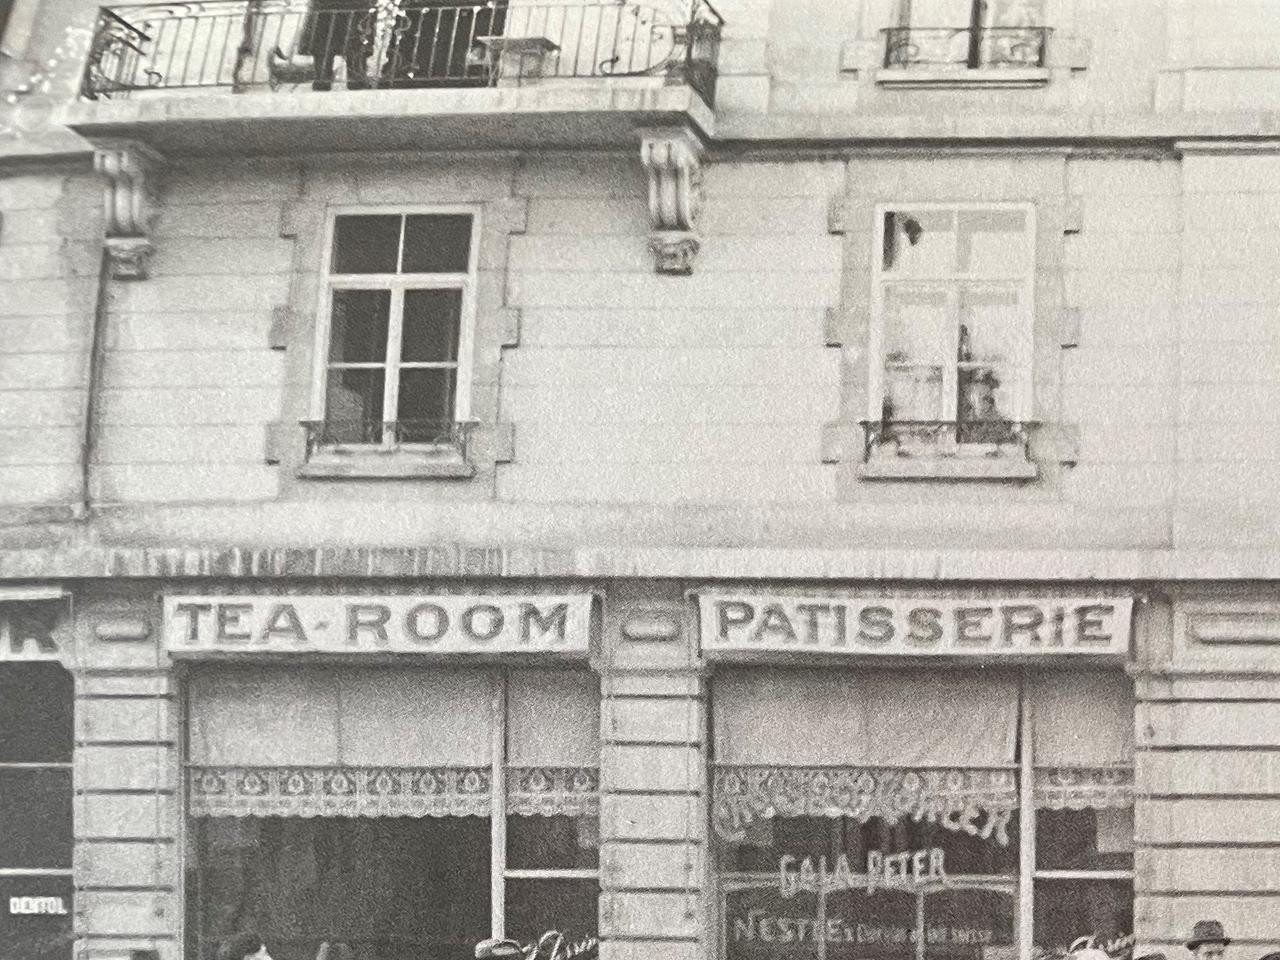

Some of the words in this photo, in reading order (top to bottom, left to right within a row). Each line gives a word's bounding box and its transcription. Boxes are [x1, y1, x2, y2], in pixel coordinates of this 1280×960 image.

[176, 602, 570, 642] TEA-ROOM
[714, 600, 1114, 645] PATISSERIE
[866, 848, 946, 896] PETER
